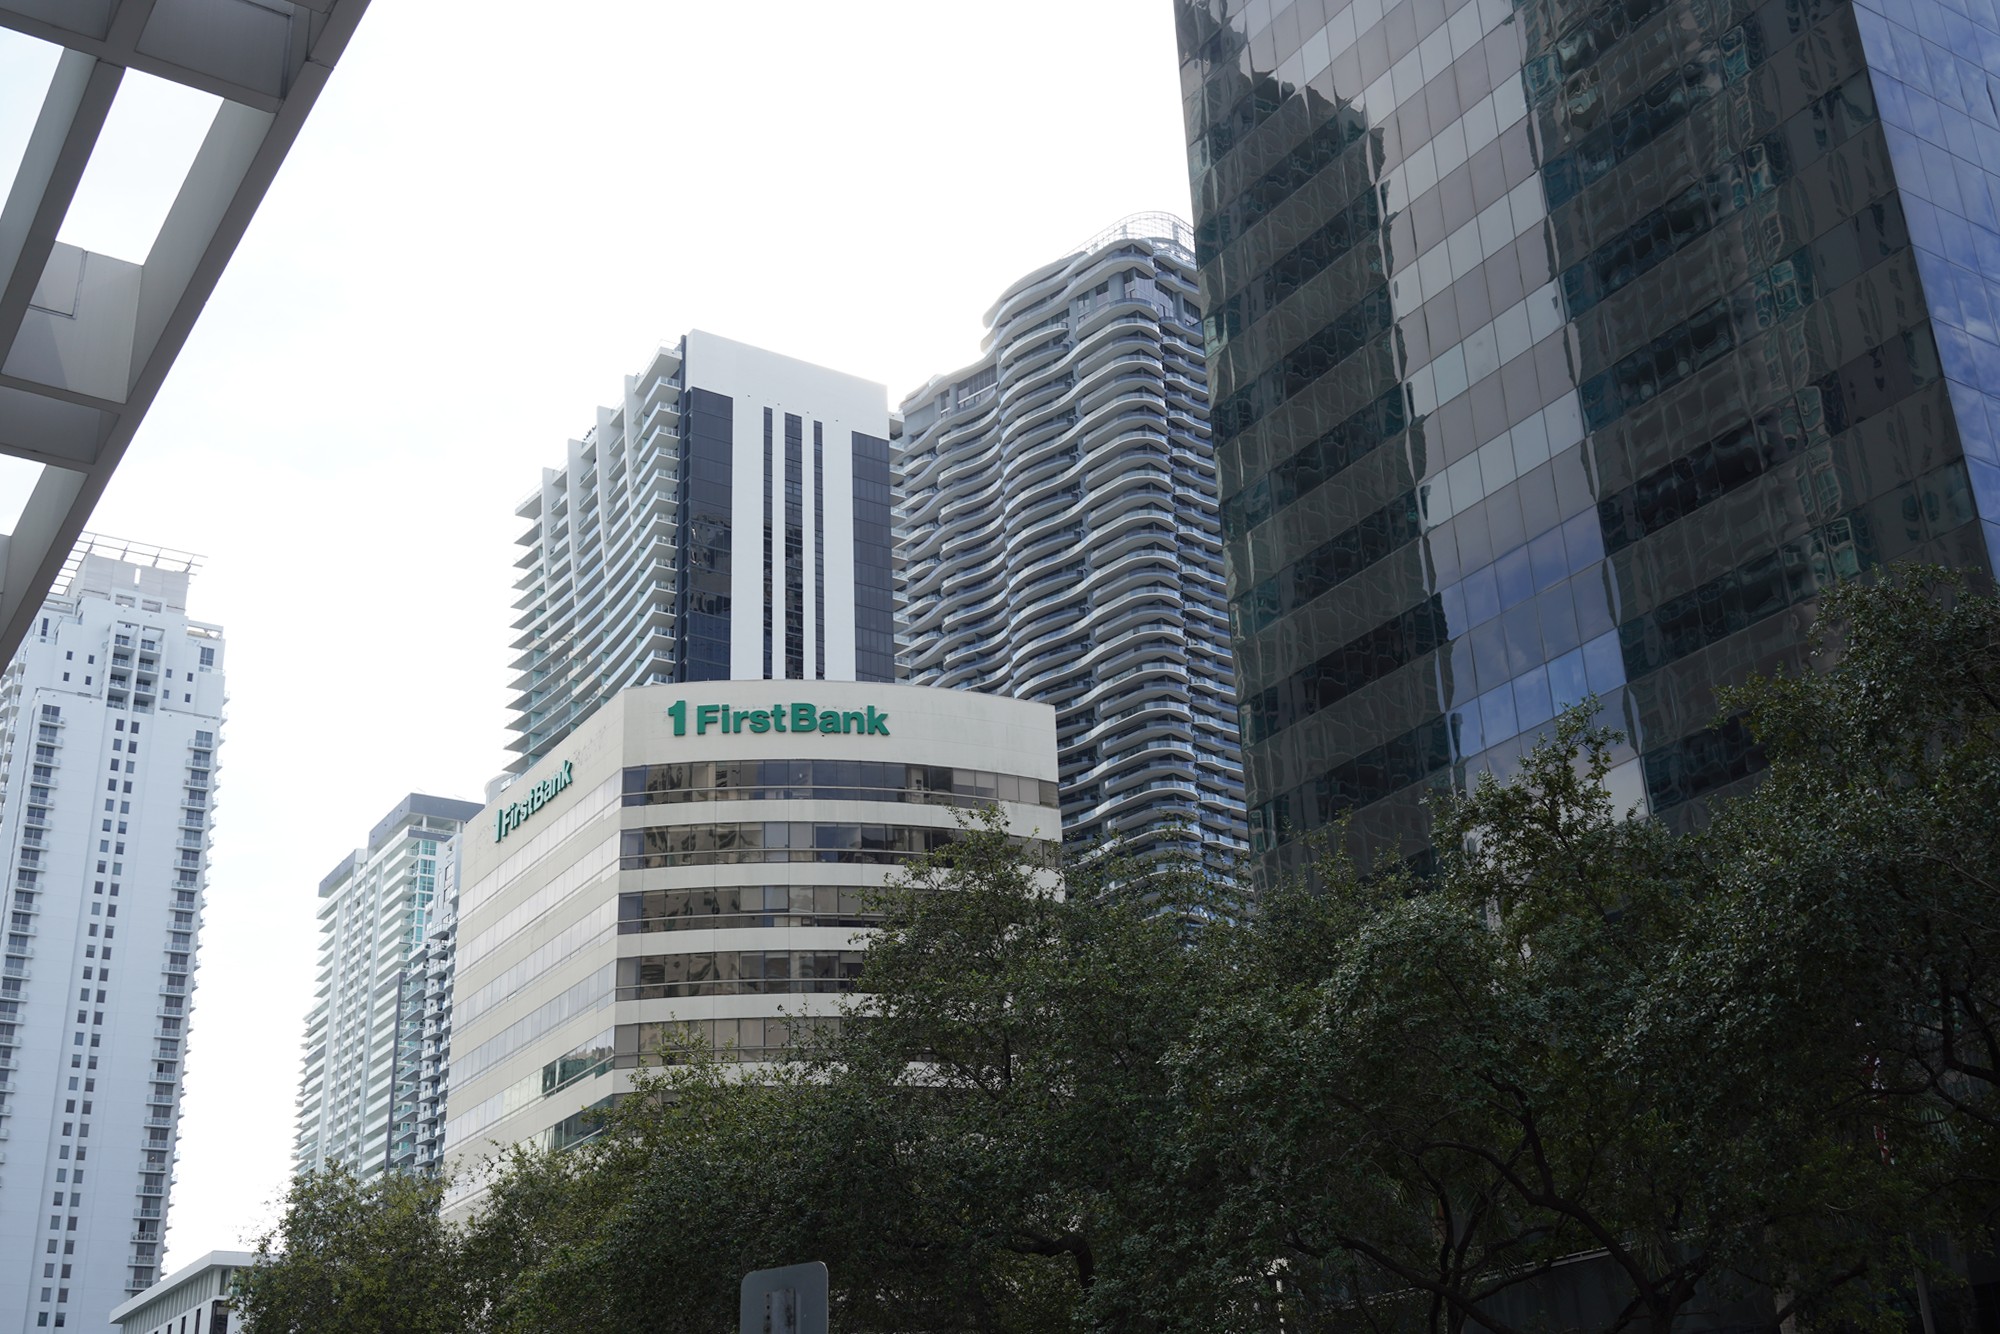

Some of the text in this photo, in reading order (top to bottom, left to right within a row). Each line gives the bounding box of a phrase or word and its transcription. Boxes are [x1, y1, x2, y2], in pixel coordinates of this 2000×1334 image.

[667, 700, 890, 736] 1 FirstBank
[503, 759, 573, 837] FirstBank
